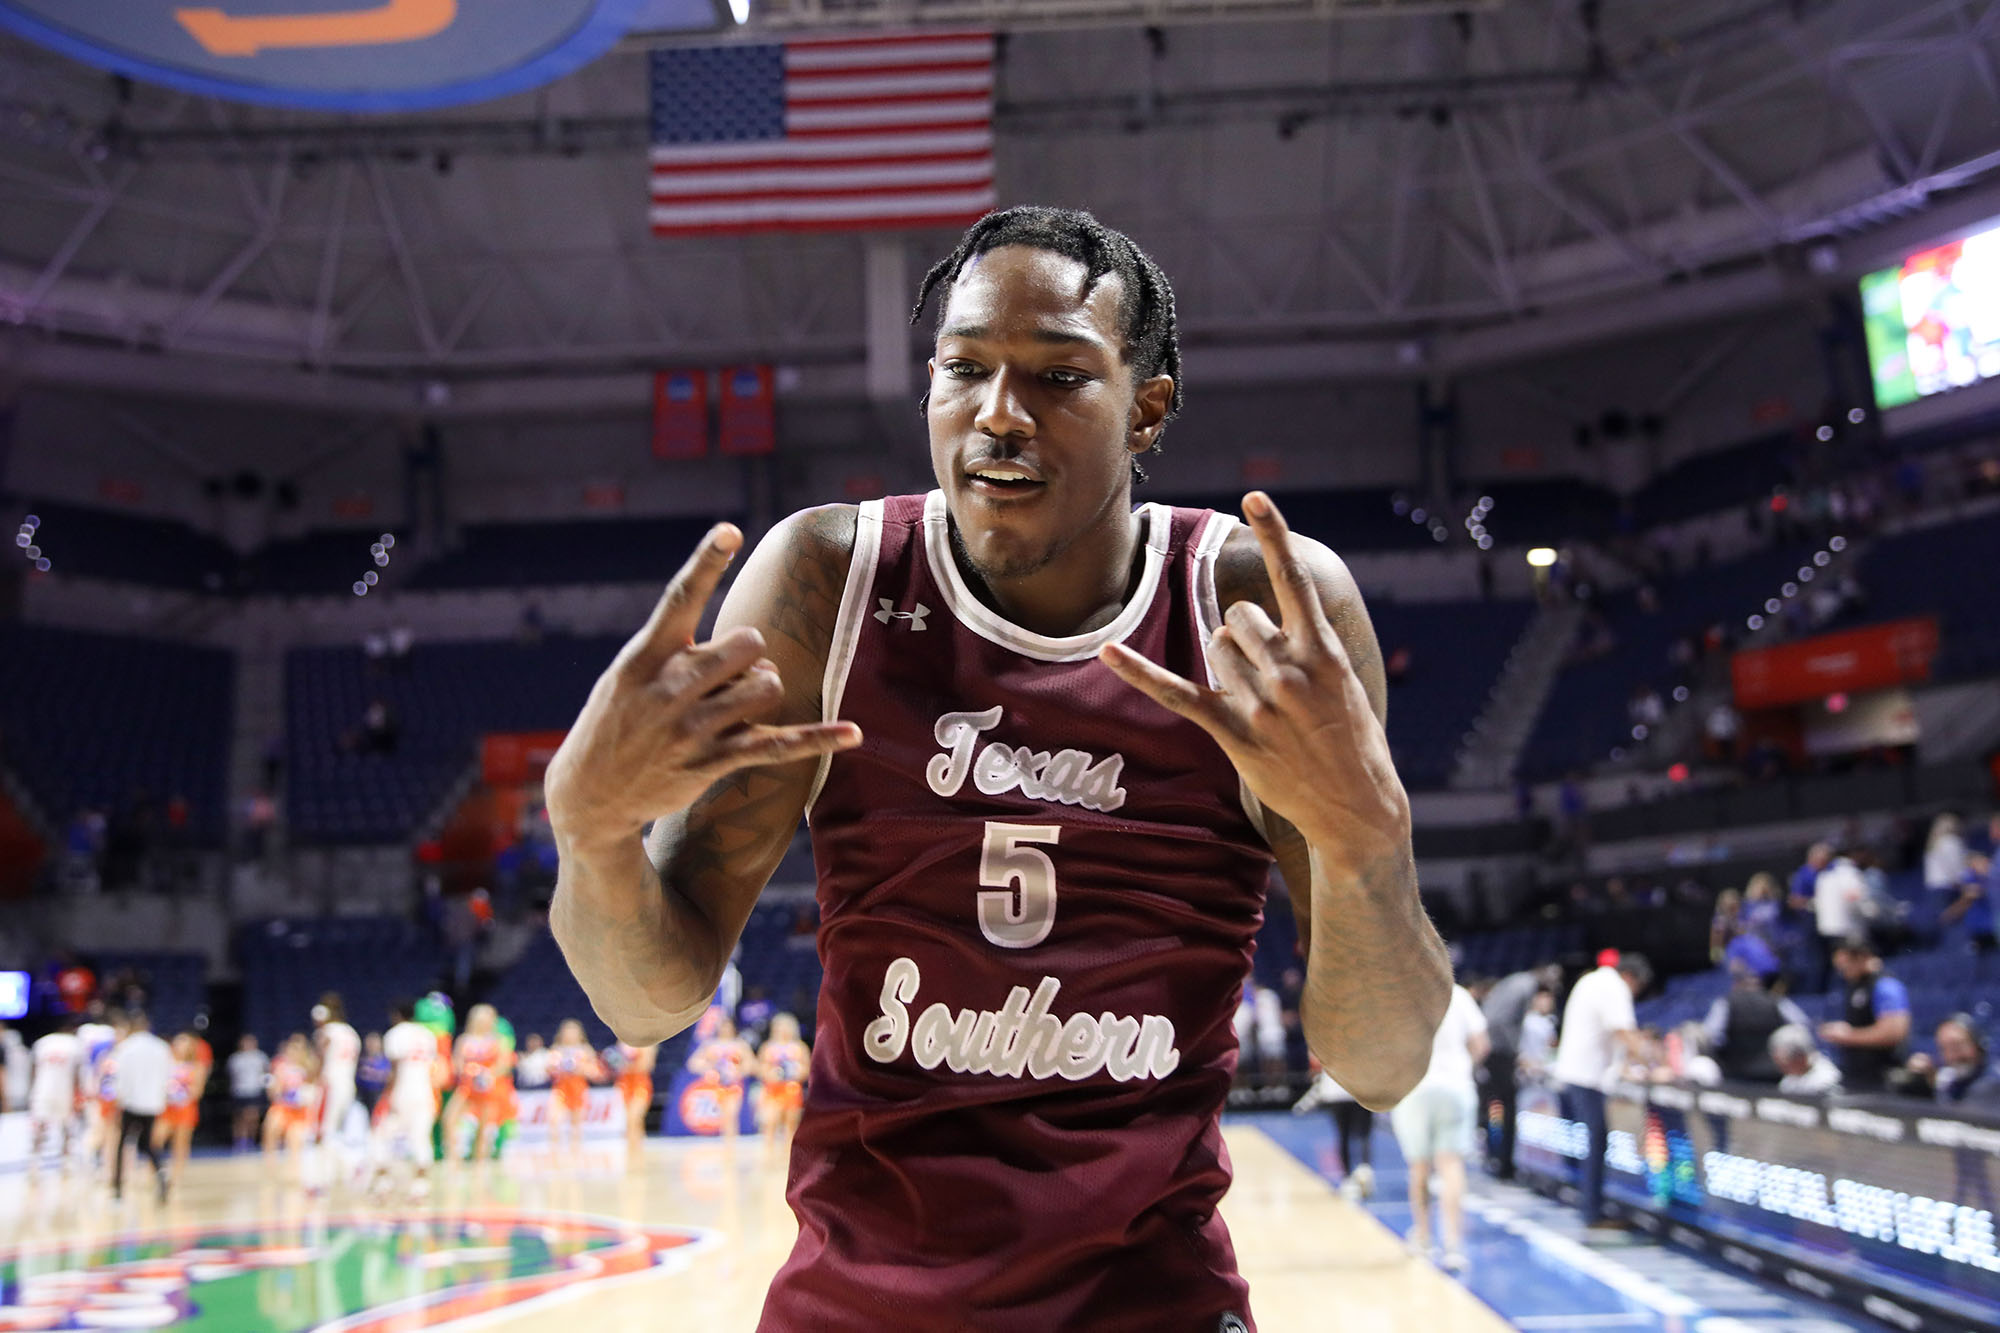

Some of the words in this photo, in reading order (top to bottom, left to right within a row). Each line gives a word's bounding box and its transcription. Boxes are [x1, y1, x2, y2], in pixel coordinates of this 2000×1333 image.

[926, 705, 1126, 811] Texas
[977, 821, 1061, 948] 5
[863, 957, 1180, 1081] Southern
